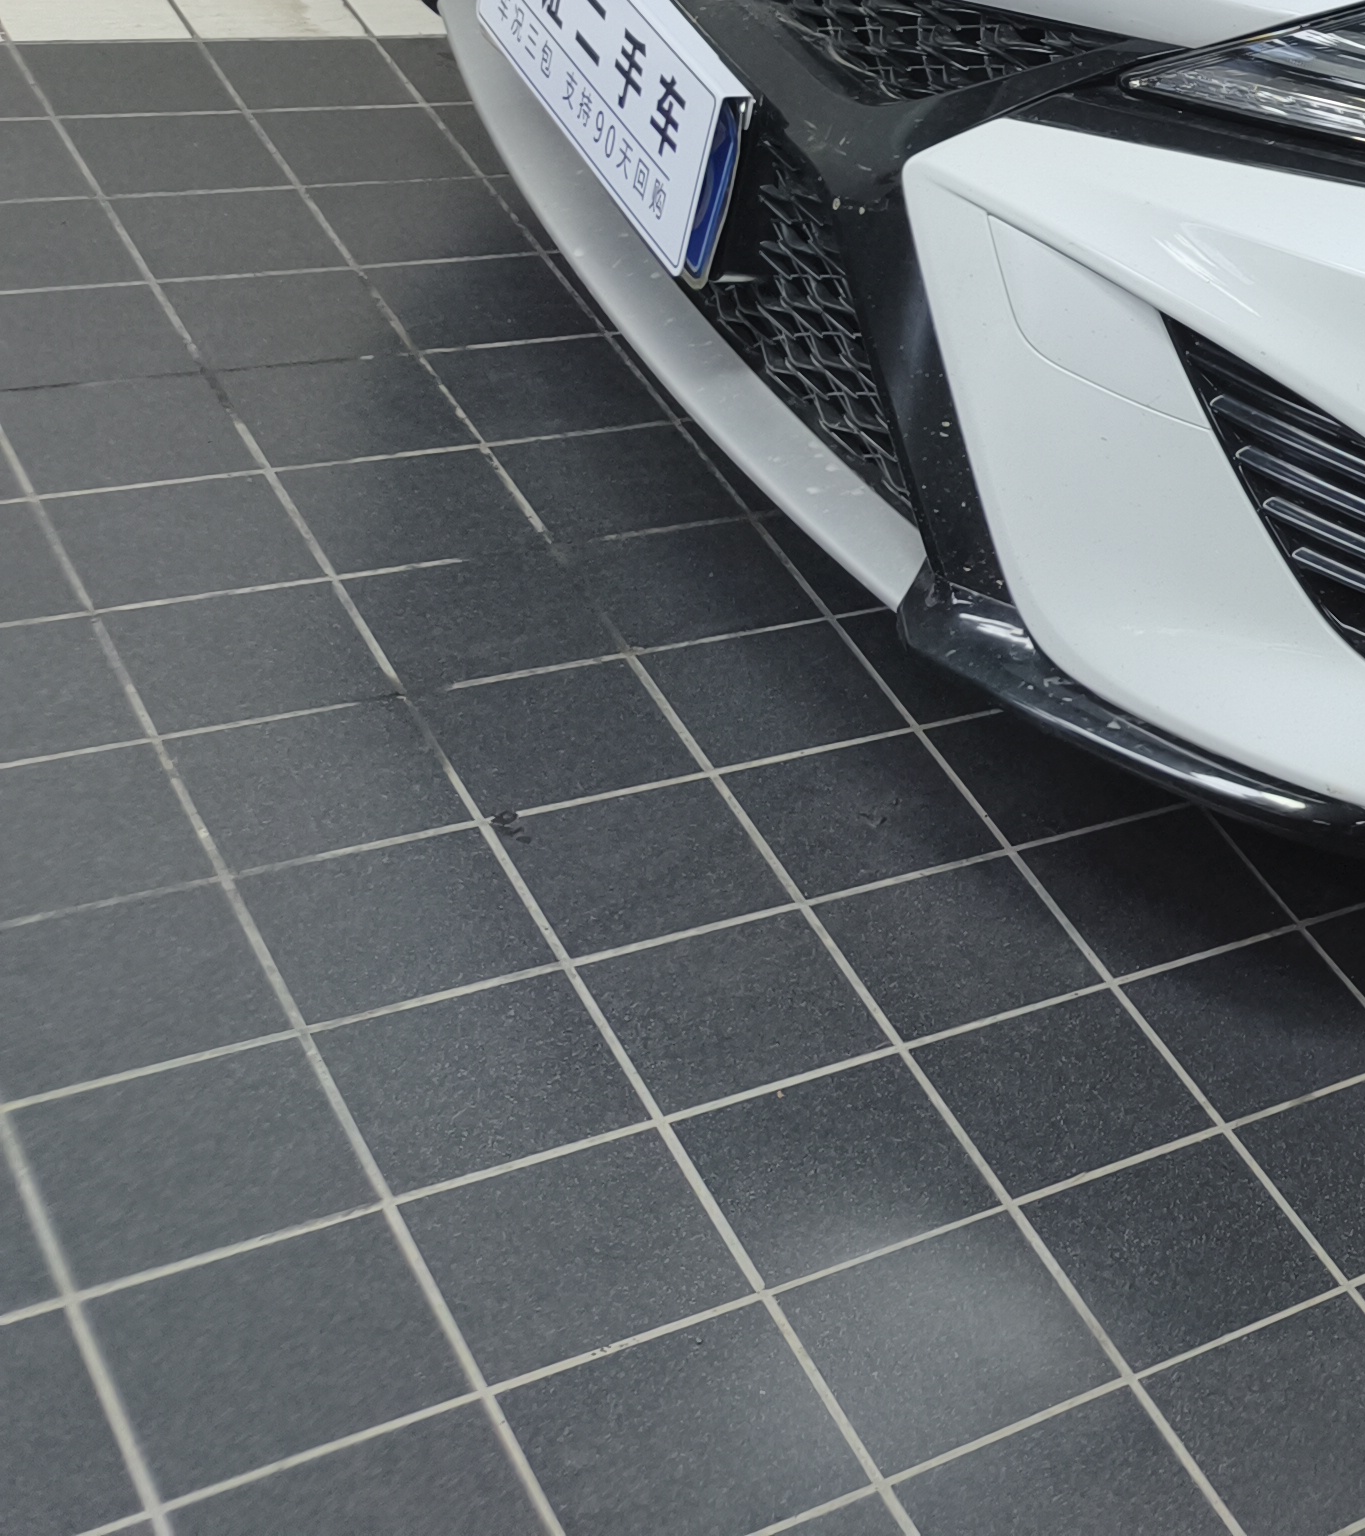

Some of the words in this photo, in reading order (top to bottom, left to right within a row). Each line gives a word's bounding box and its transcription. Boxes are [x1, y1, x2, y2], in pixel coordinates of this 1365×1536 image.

[561, 71, 668, 221] 支持90天回购
